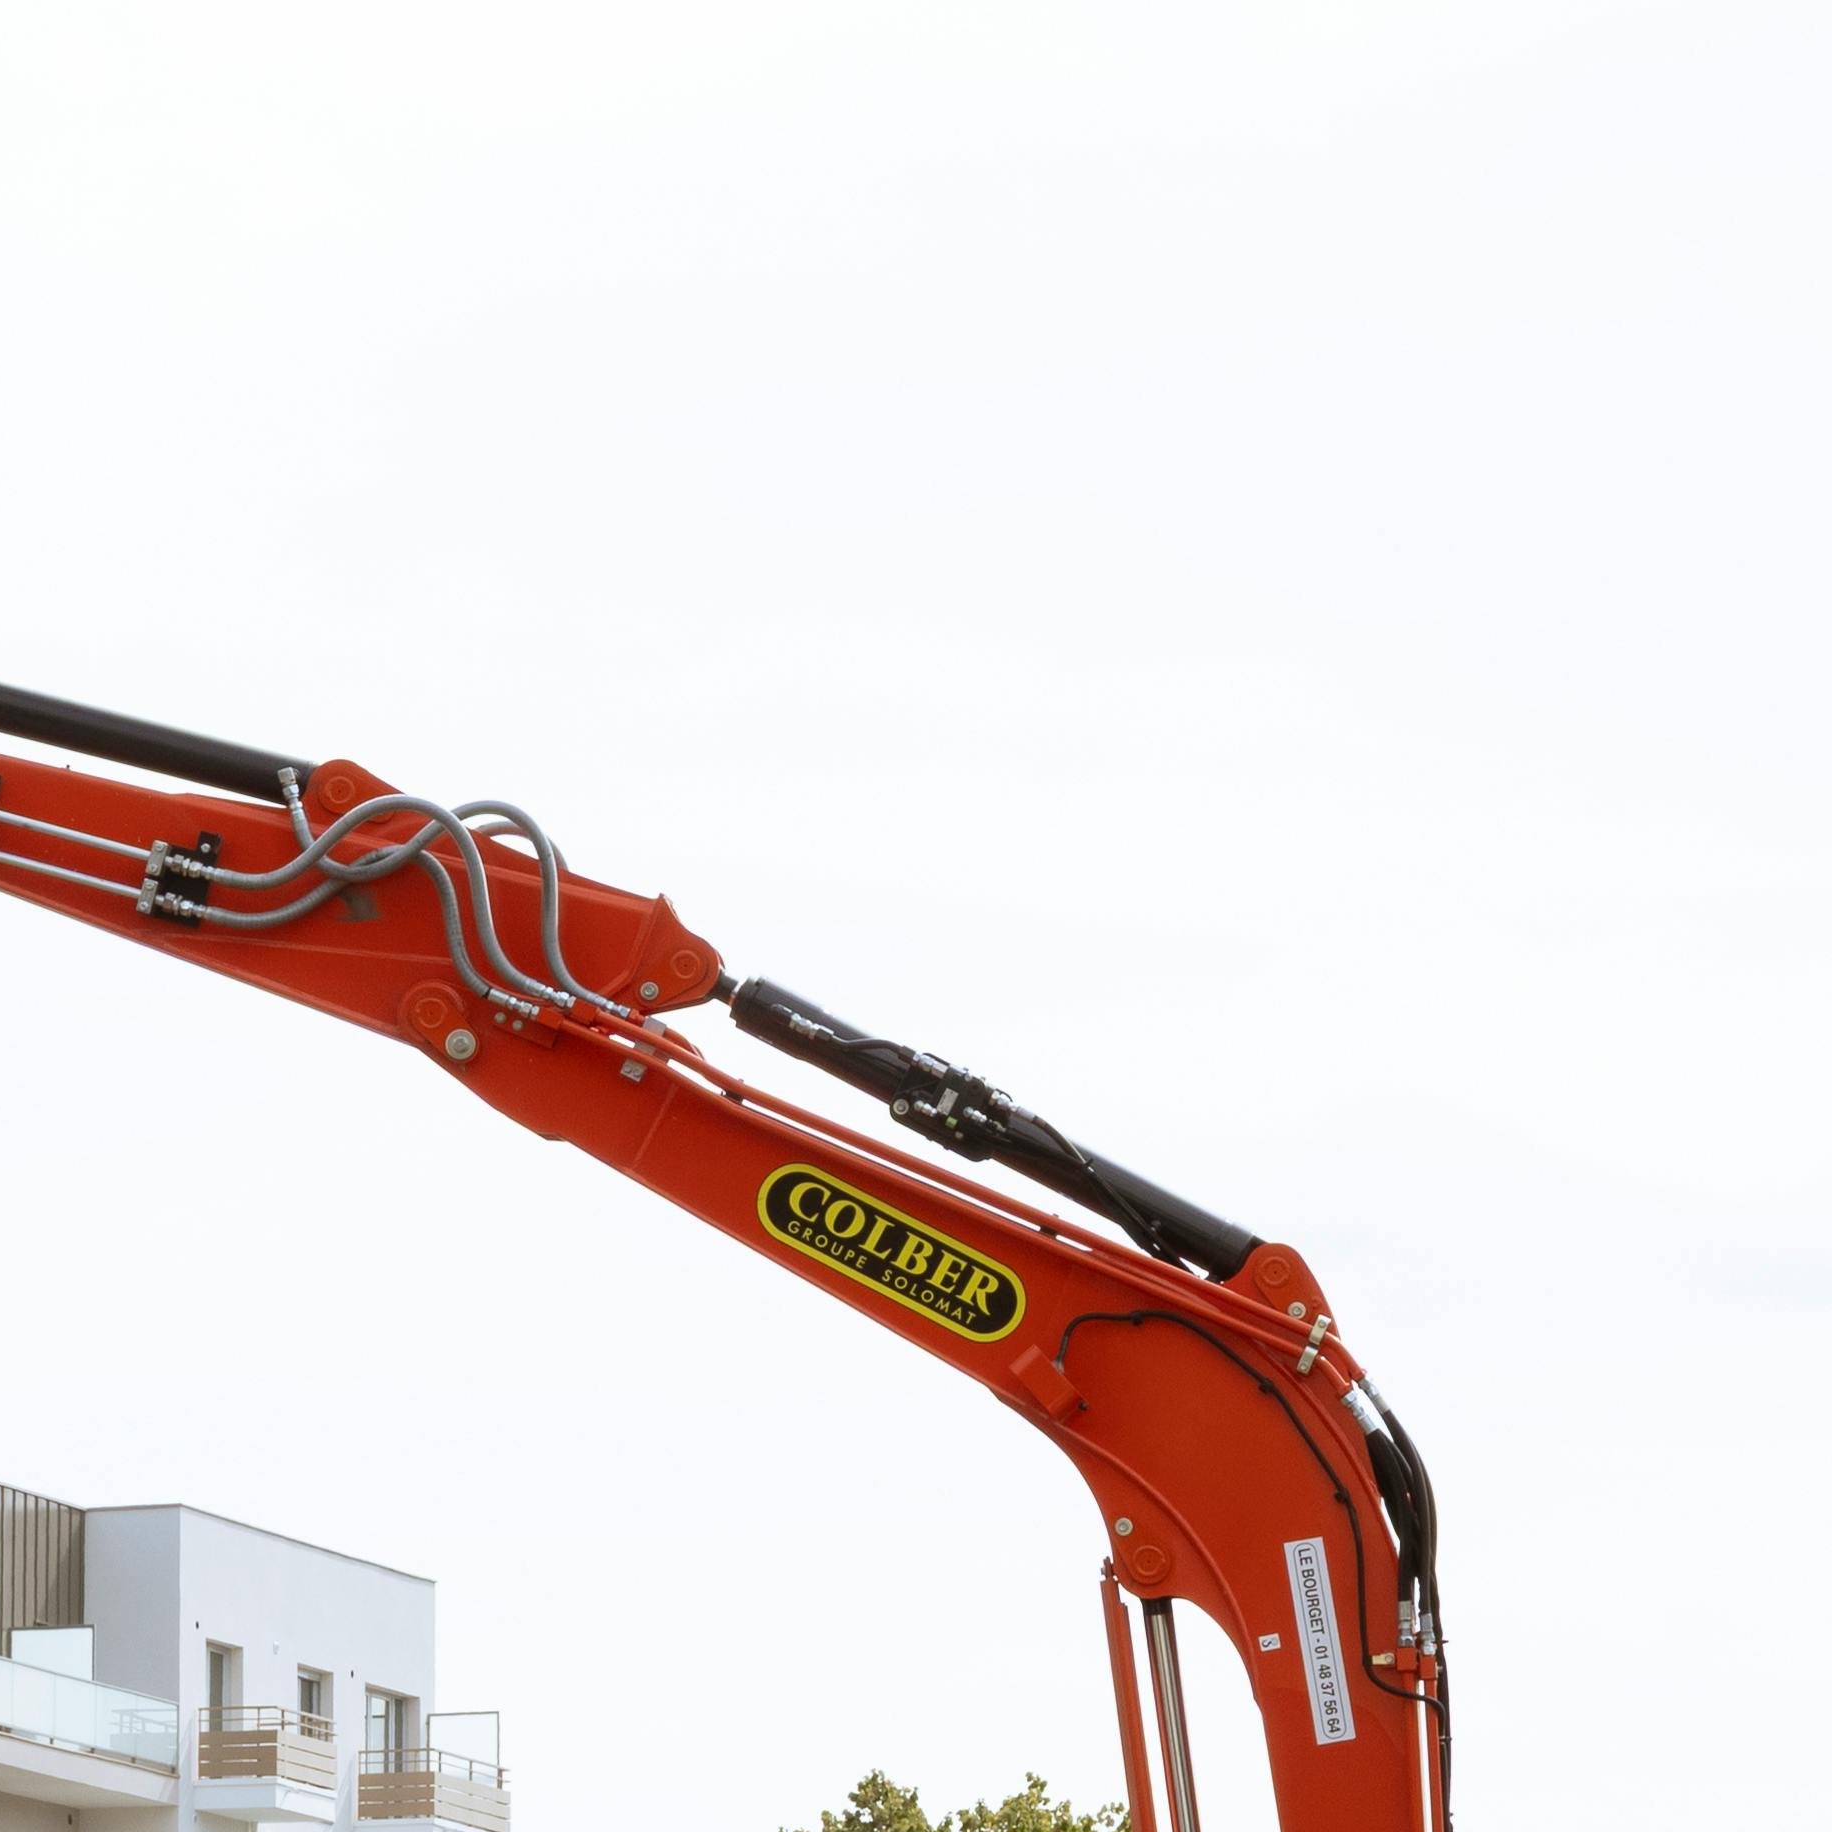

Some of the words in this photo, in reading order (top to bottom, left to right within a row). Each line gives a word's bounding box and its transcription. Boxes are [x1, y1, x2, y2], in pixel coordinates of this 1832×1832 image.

[788, 1180, 1000, 1316] COLBER
[787, 1220, 868, 1270] GROUPE
[881, 1268, 977, 1326] SOLOMAT
[1297, 1547, 1314, 1567] LE
[1301, 1568, 1326, 1635] BOURGET
[1314, 1645, 1329, 1660] 01
[1318, 1663, 1332, 1680] 48
[1321, 1681, 1336, 1697] 37
[1323, 1699, 1338, 1716] 56
[1326, 1717, 1342, 1734] 64
